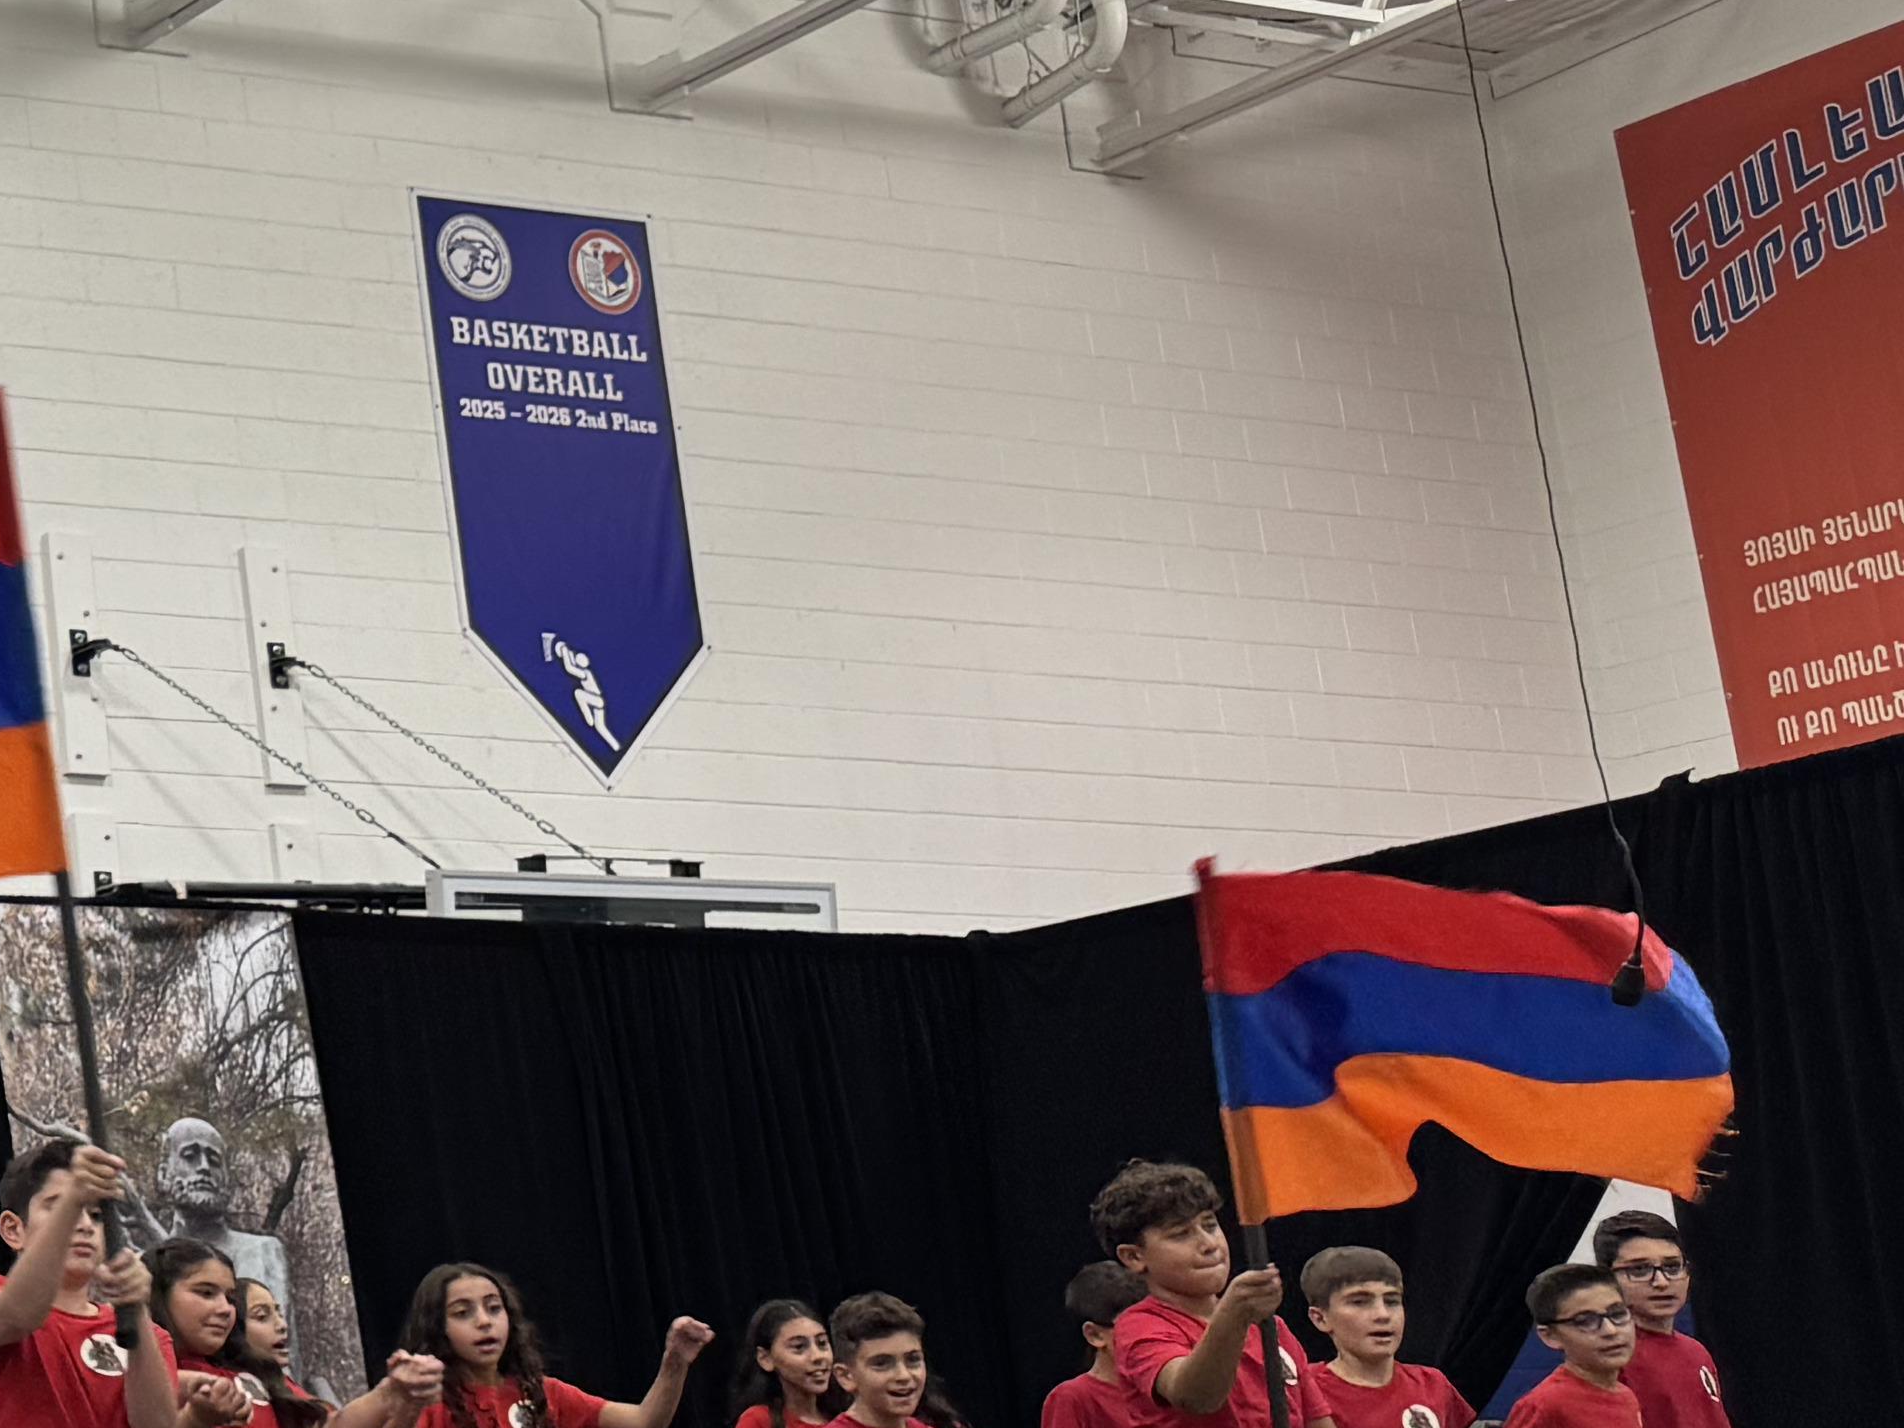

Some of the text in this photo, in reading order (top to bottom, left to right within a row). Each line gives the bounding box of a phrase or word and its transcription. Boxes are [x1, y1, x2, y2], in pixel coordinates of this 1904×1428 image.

[1692, 151, 1904, 346] ՎԱՐԺԱՐ
[450, 316, 647, 362] BASKETBALL
[487, 362, 623, 401] OVERALL
[460, 398, 658, 434] 2025 2026 2nd Place
